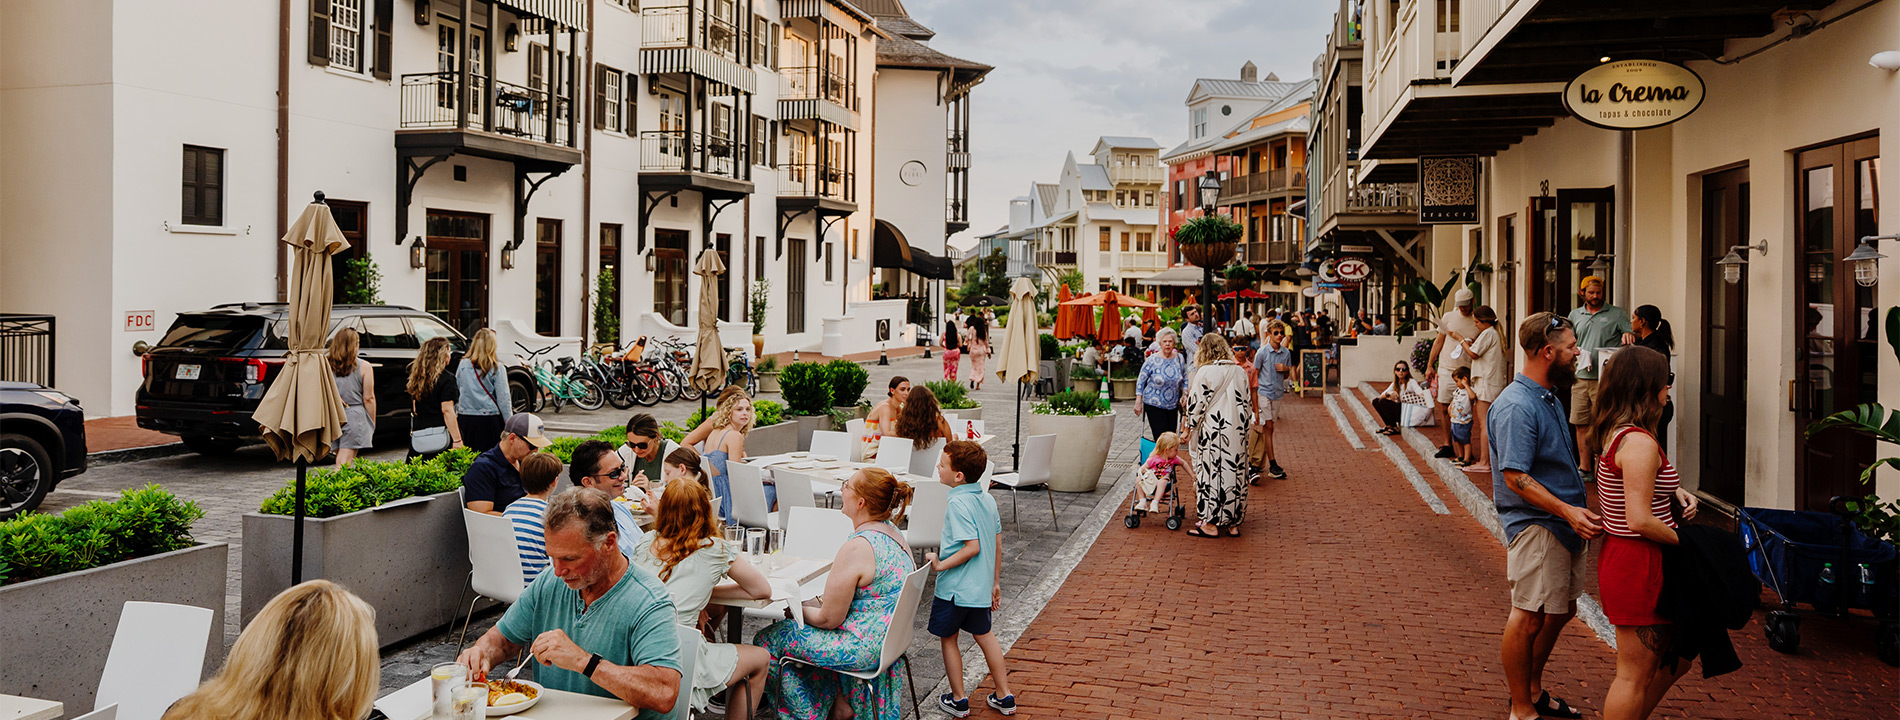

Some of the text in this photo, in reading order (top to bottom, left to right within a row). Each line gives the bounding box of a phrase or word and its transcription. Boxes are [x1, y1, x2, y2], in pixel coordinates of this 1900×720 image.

[1580, 82, 1690, 104] la Crema
[1599, 108, 1672, 119] tapas & chocolate
[1539, 179, 1550, 197] 38
[1422, 211, 1476, 219] tracery
[1339, 263, 1365, 276] CK
[127, 314, 152, 327] FDC
